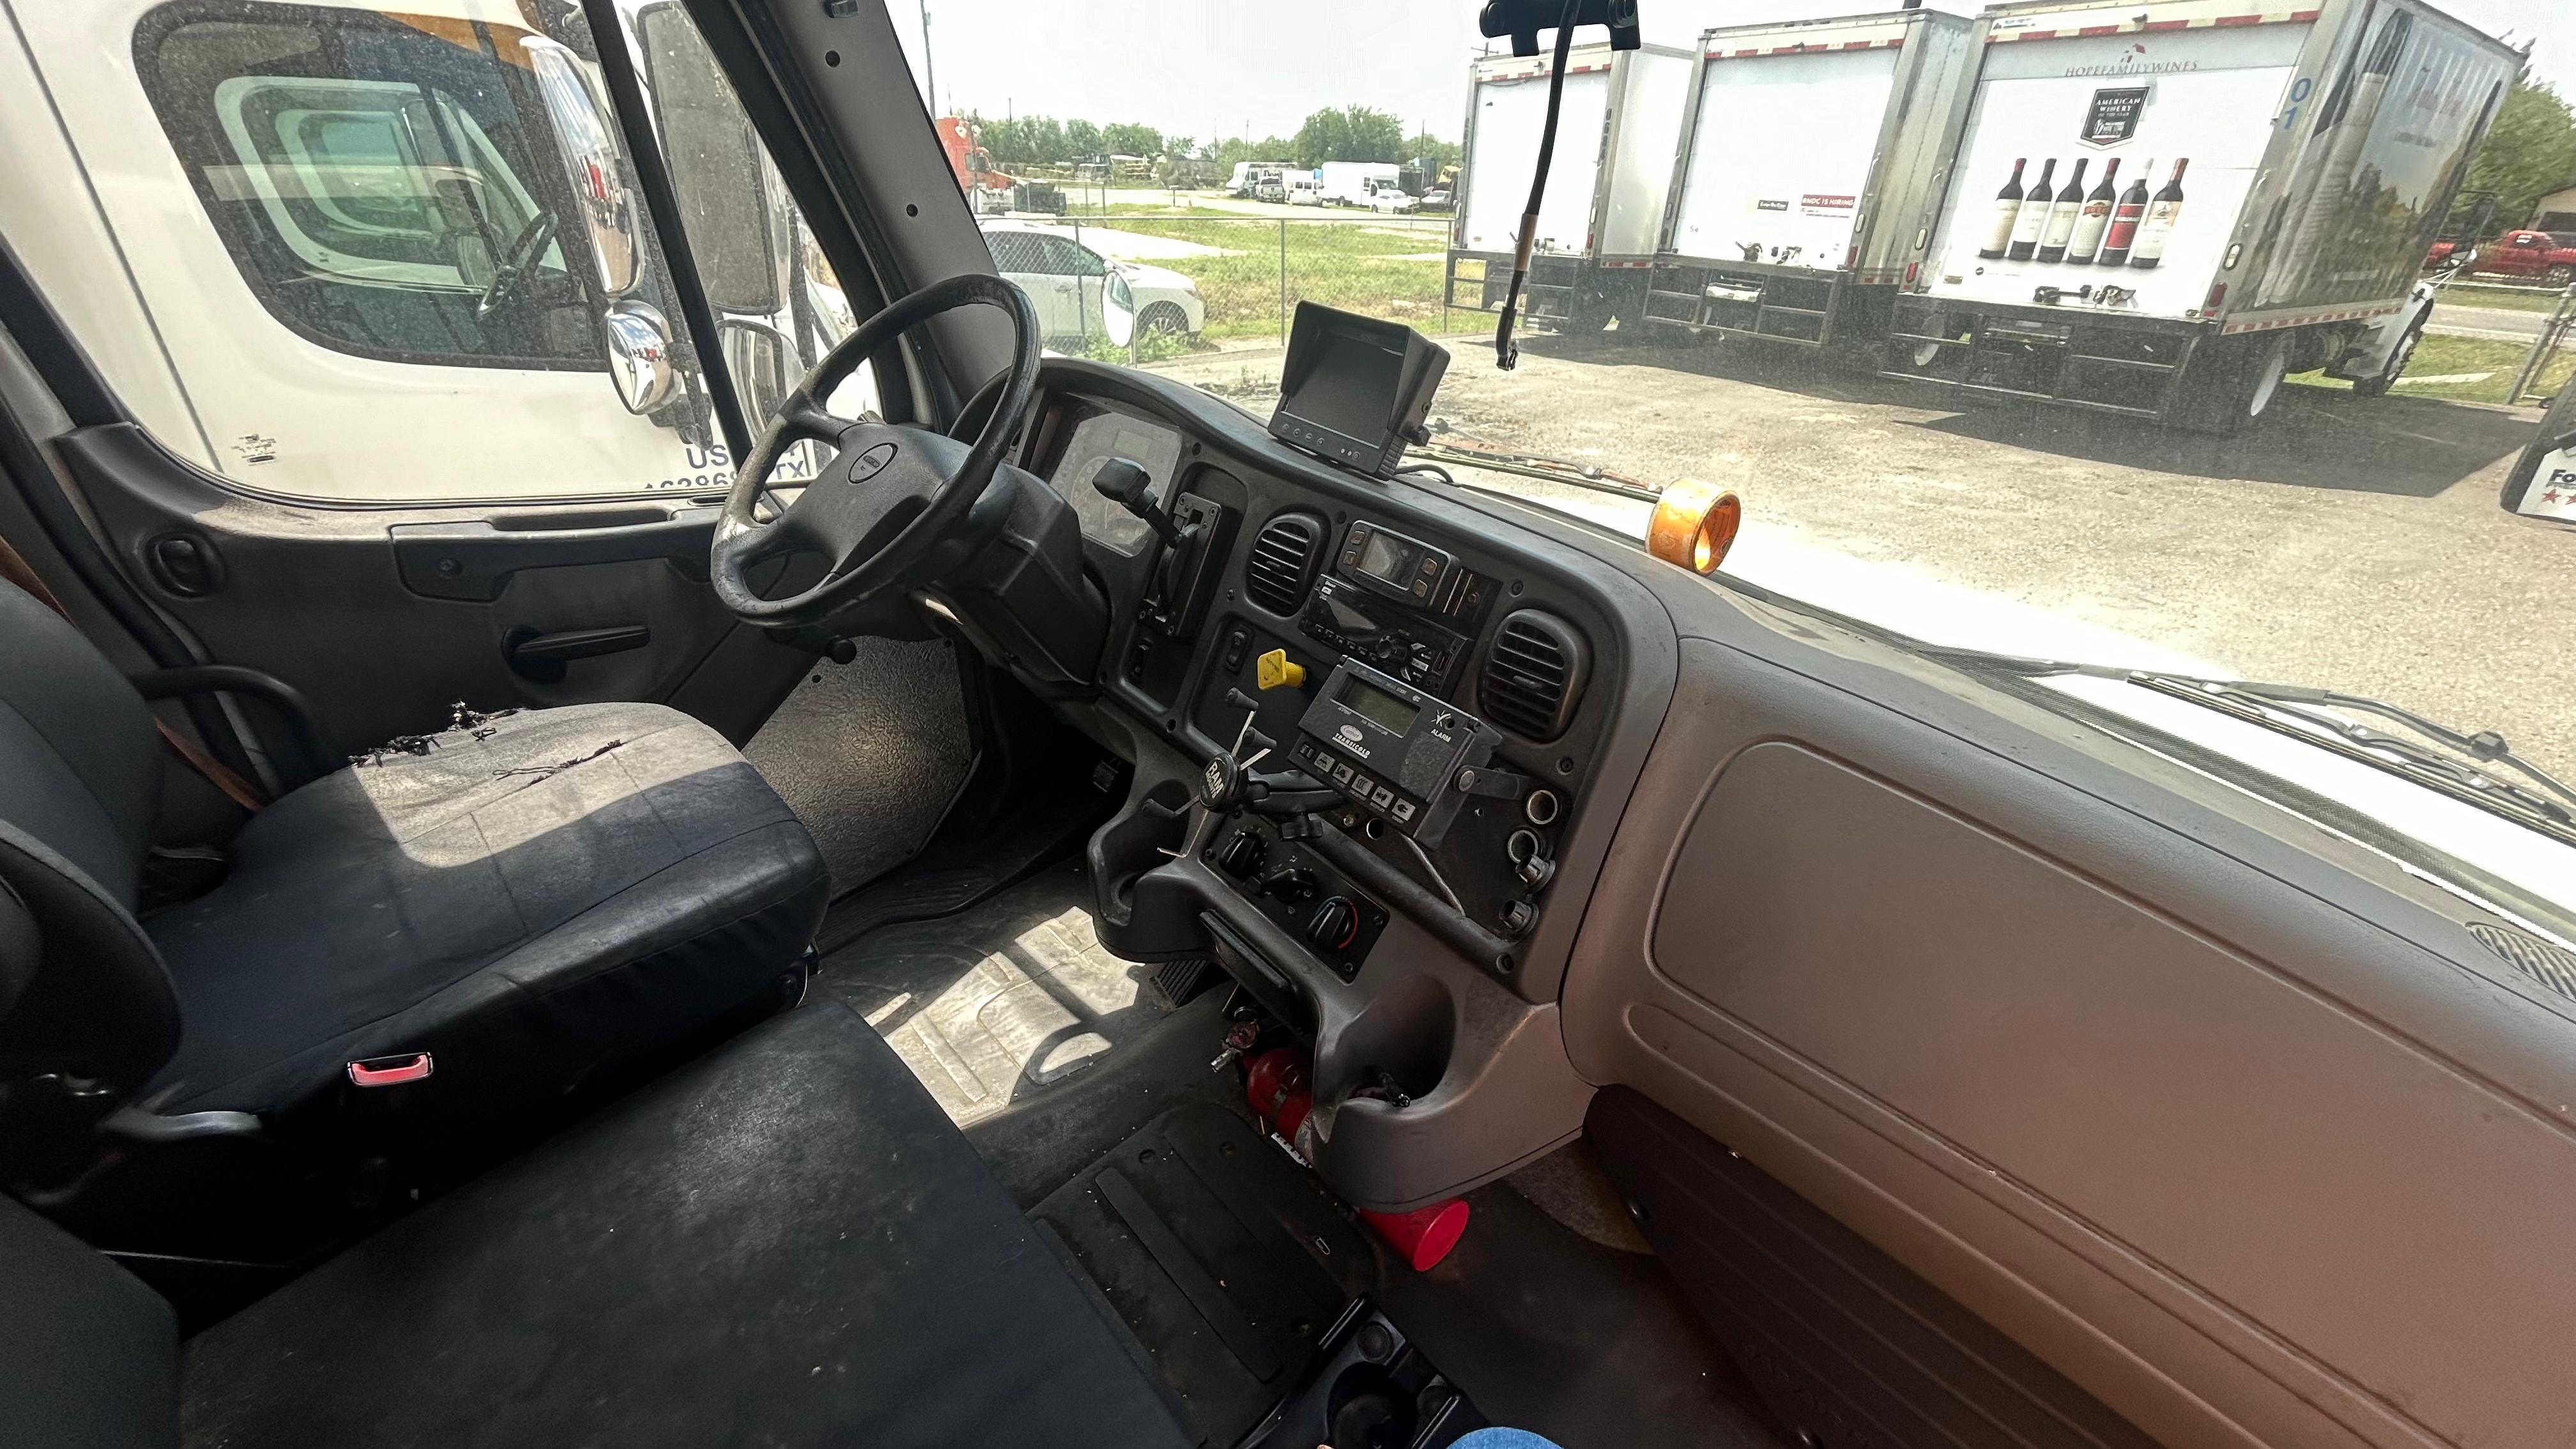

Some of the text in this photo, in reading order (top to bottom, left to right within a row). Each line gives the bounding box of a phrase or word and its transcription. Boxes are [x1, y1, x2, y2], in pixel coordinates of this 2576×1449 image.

[2096, 97, 2141, 106] AMERICAN
[1431, 728, 1452, 742] ALARM
[1335, 733, 1370, 756] TRANSICOLD
[1208, 761, 1224, 794] RAM
